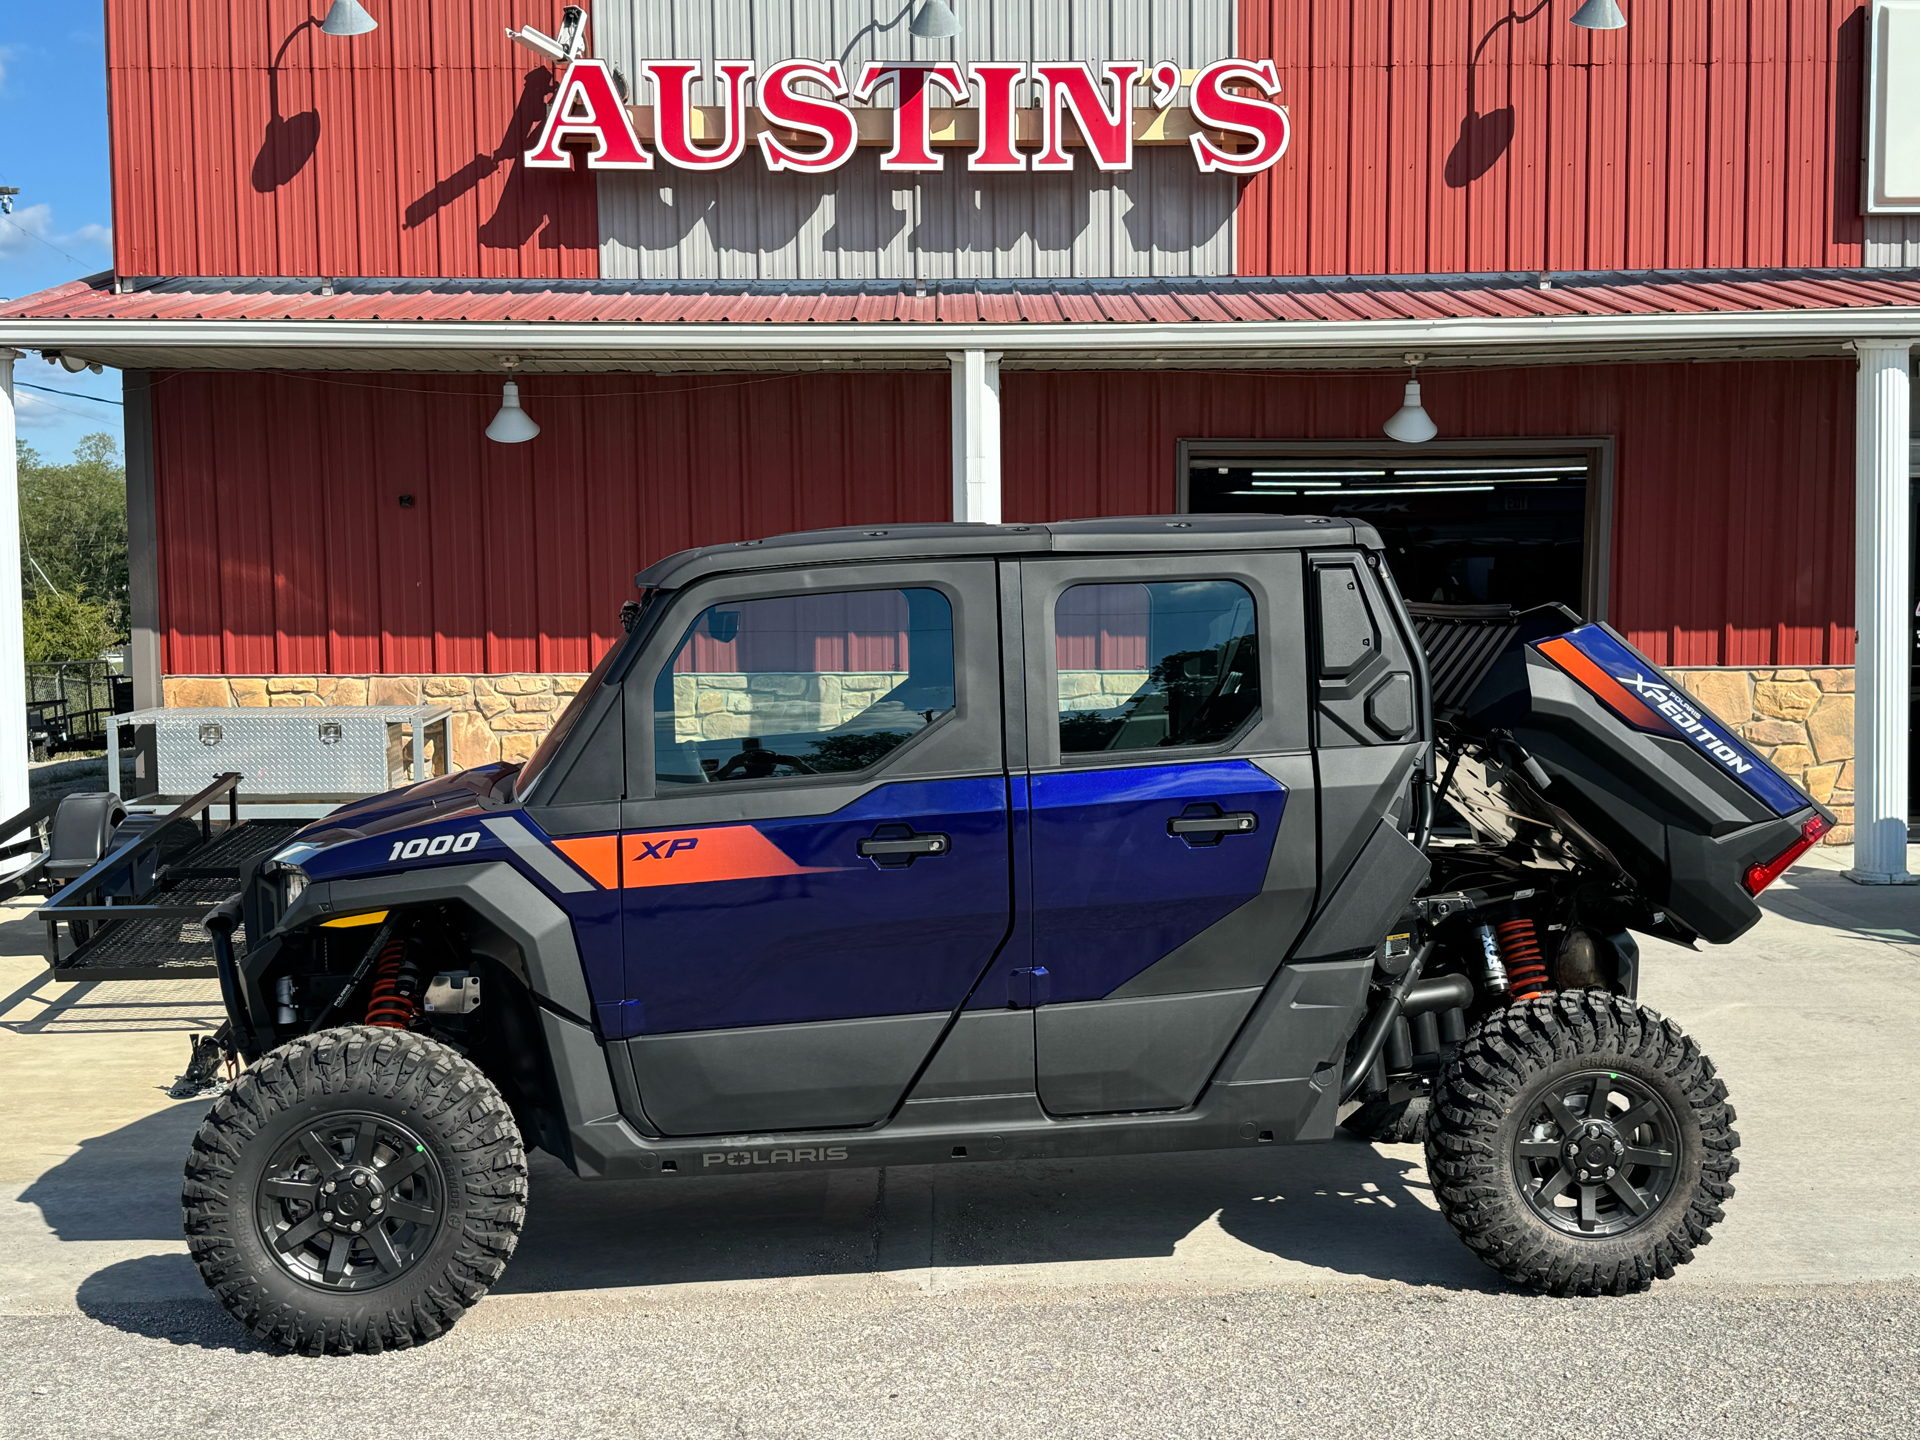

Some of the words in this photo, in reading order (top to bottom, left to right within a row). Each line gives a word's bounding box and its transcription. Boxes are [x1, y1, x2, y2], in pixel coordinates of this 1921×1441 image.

[524, 58, 1289, 173] AUSTIN'S
[1669, 690, 1702, 720] POLARIS
[1616, 673, 1752, 775] XPEDITION
[388, 832, 481, 861] 1000
[632, 838, 699, 861] XP
[420, 1124, 448, 1155] PRO
[441, 1153, 462, 1210] ARMOR
[702, 1146, 849, 1168] POLARIS
